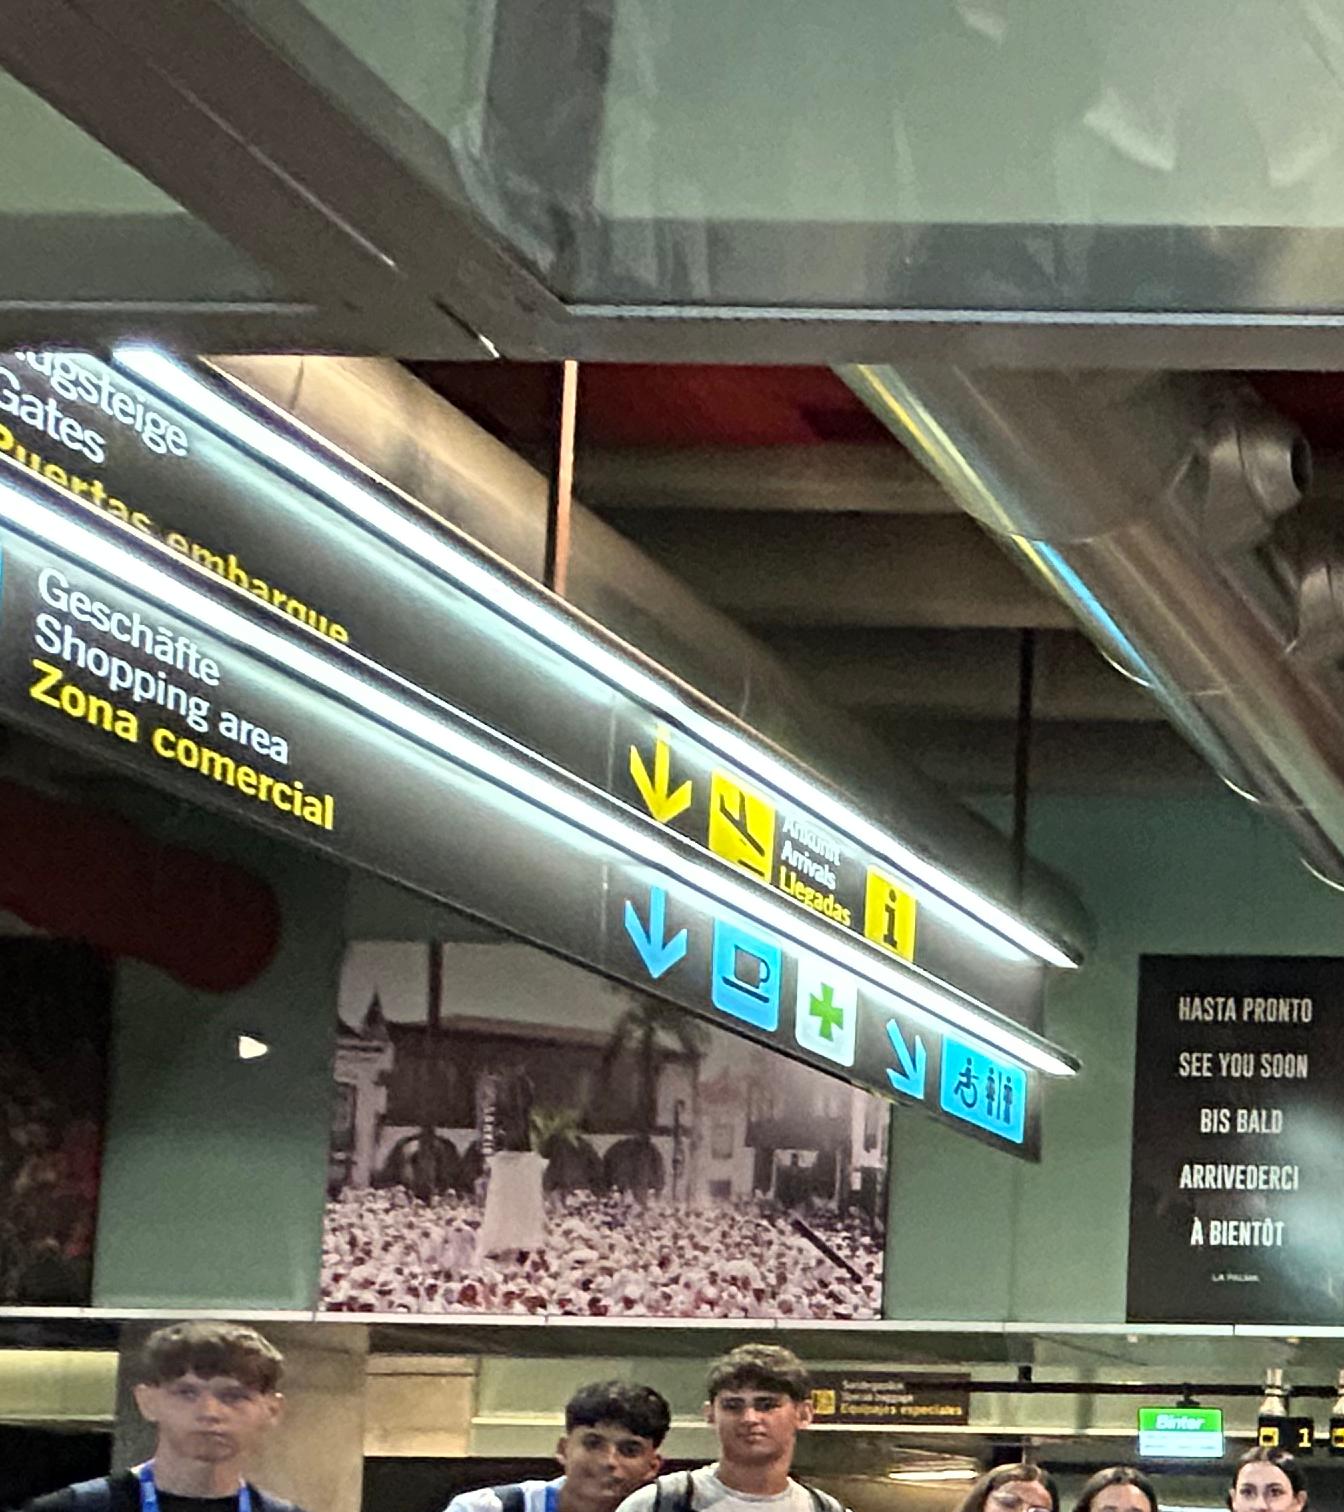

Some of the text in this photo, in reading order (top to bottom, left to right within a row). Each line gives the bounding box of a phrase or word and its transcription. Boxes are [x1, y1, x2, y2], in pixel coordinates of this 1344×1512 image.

[0, 366, 107, 464] Gates
[15, 351, 188, 457] ugsteige
[38, 567, 220, 686] Geschäfte
[35, 613, 289, 764] Shopping area
[29, 658, 334, 830] Zona comercial
[781, 840, 836, 890] Arrivals
[780, 865, 852, 926] Llegadas
[1178, 997, 1313, 1023] HASTA PRONTO
[1178, 1052, 1308, 1079] SEE YOU SOON
[1200, 1108, 1282, 1134] BIS BALD
[1179, 1164, 1299, 1190] ARRIVEDERCI
[1190, 1216, 1285, 1246] À BIENTÔT
[1155, 1414, 1206, 1430] Binter
[1298, 1427, 1312, 1448] 1
